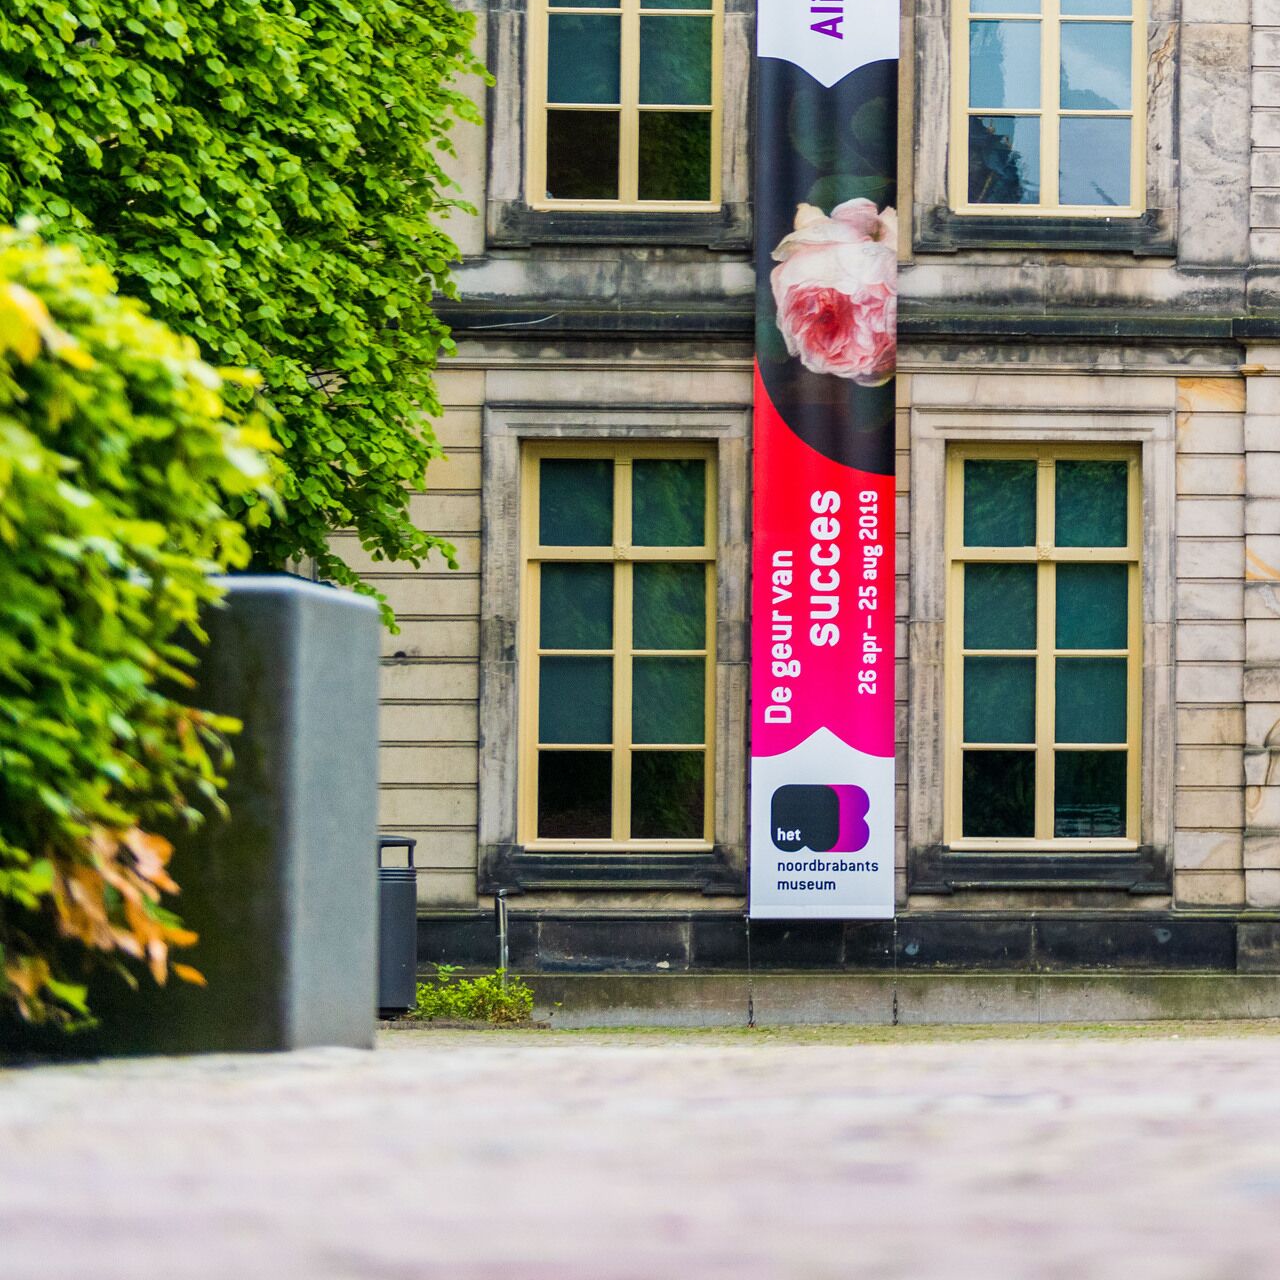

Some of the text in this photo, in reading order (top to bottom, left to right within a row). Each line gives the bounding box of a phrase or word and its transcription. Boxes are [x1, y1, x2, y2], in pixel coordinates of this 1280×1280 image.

[858, 490, 878, 540] 2019
[809, 490, 841, 647] succes
[862, 544, 883, 580] aug
[858, 585, 877, 610] 25
[764, 550, 801, 724] De geur van
[862, 632, 882, 664] apr
[858, 670, 877, 694] 26
[777, 827, 801, 841] het
[777, 859, 879, 872] noordbrabants
[777, 880, 836, 890] museum
